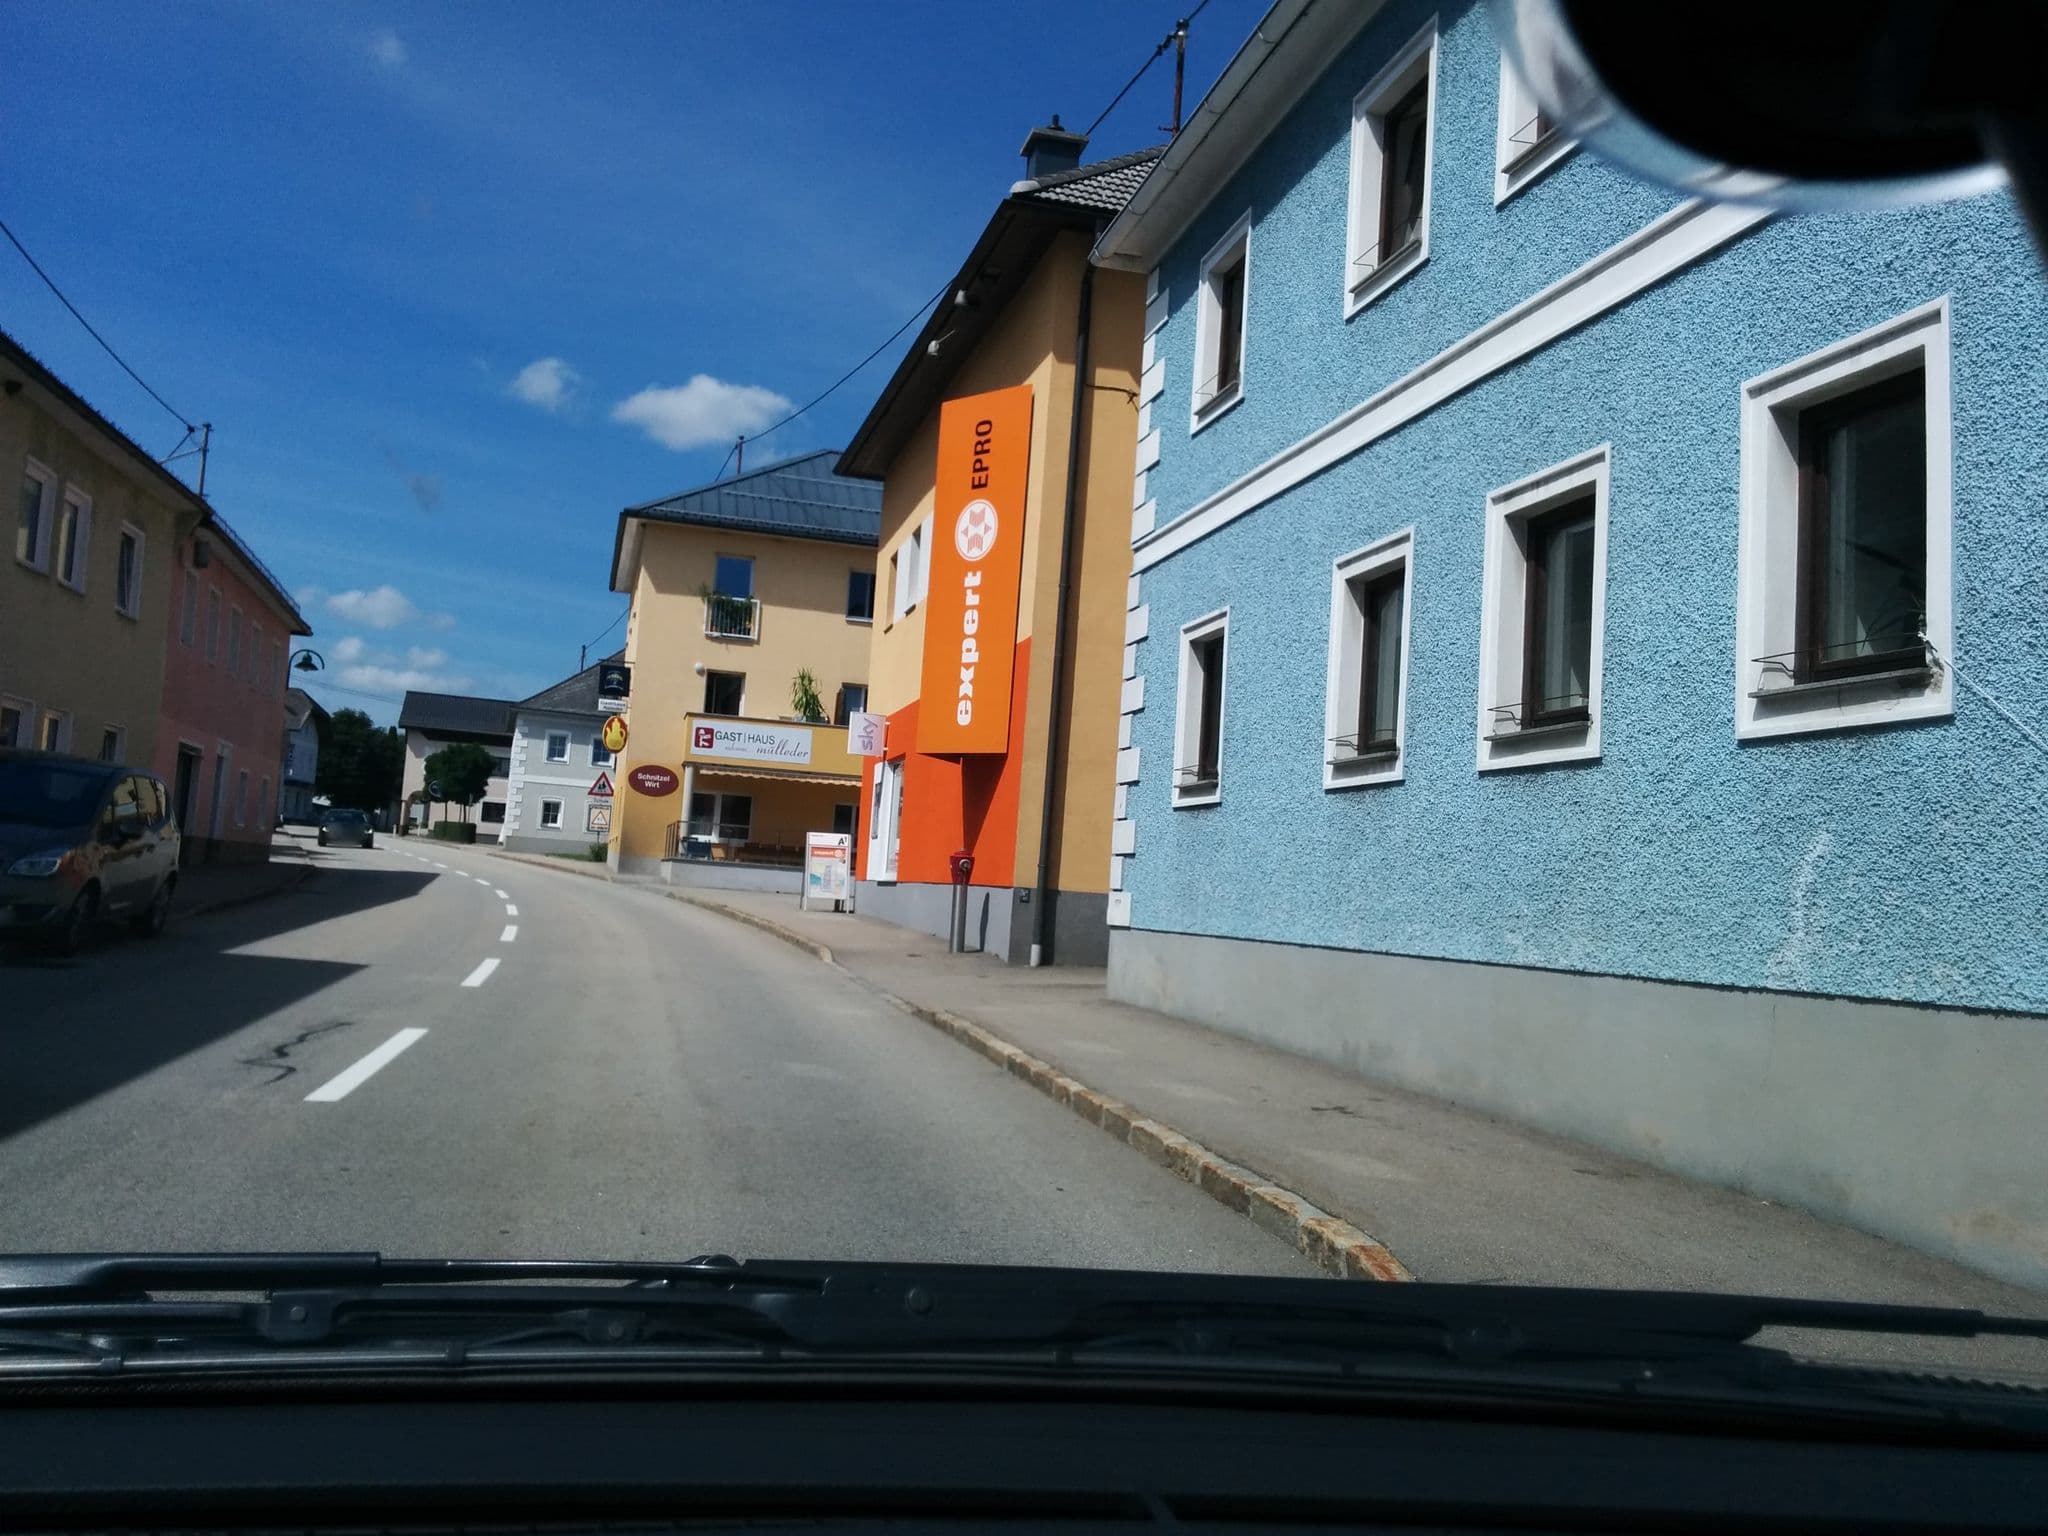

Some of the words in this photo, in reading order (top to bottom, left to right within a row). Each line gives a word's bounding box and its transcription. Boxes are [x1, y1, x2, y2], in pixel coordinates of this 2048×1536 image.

[971, 419, 993, 490] EPRO
[956, 570, 982, 726] expert
[857, 717, 878, 751] sky
[637, 772, 670, 783] Schnitzel
[644, 780, 660, 789] Wirt
